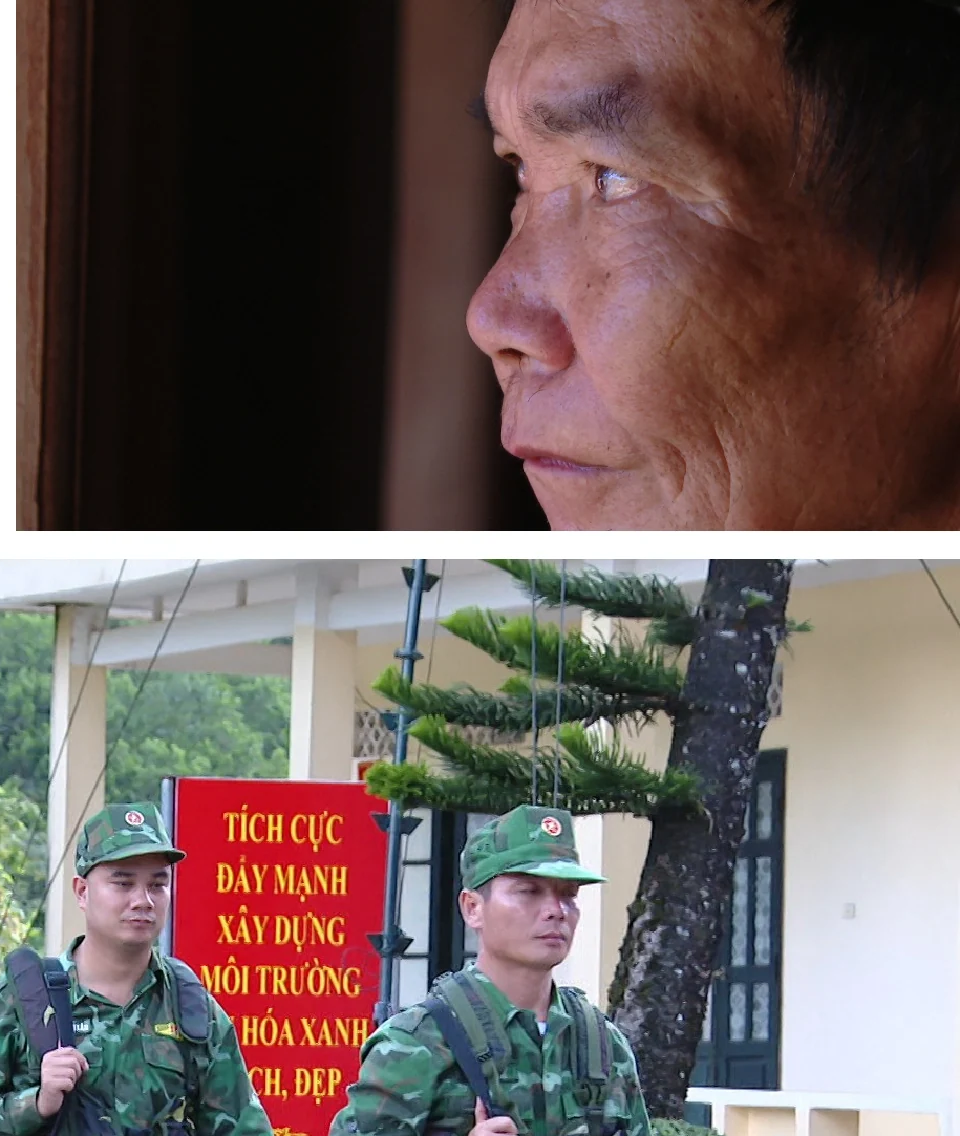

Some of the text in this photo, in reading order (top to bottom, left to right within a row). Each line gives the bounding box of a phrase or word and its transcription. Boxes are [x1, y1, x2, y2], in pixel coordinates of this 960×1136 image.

[222, 804, 344, 853] TÍCH CỰC
[273, 864, 348, 903] MẠNH
[216, 904, 346, 953] XÂY DỰNG
[200, 955, 362, 999] MÔI TRƯỜNG
[241, 1007, 370, 1048] HÓA XANH
[248, 1066, 342, 1105] CH, ĐẸP
